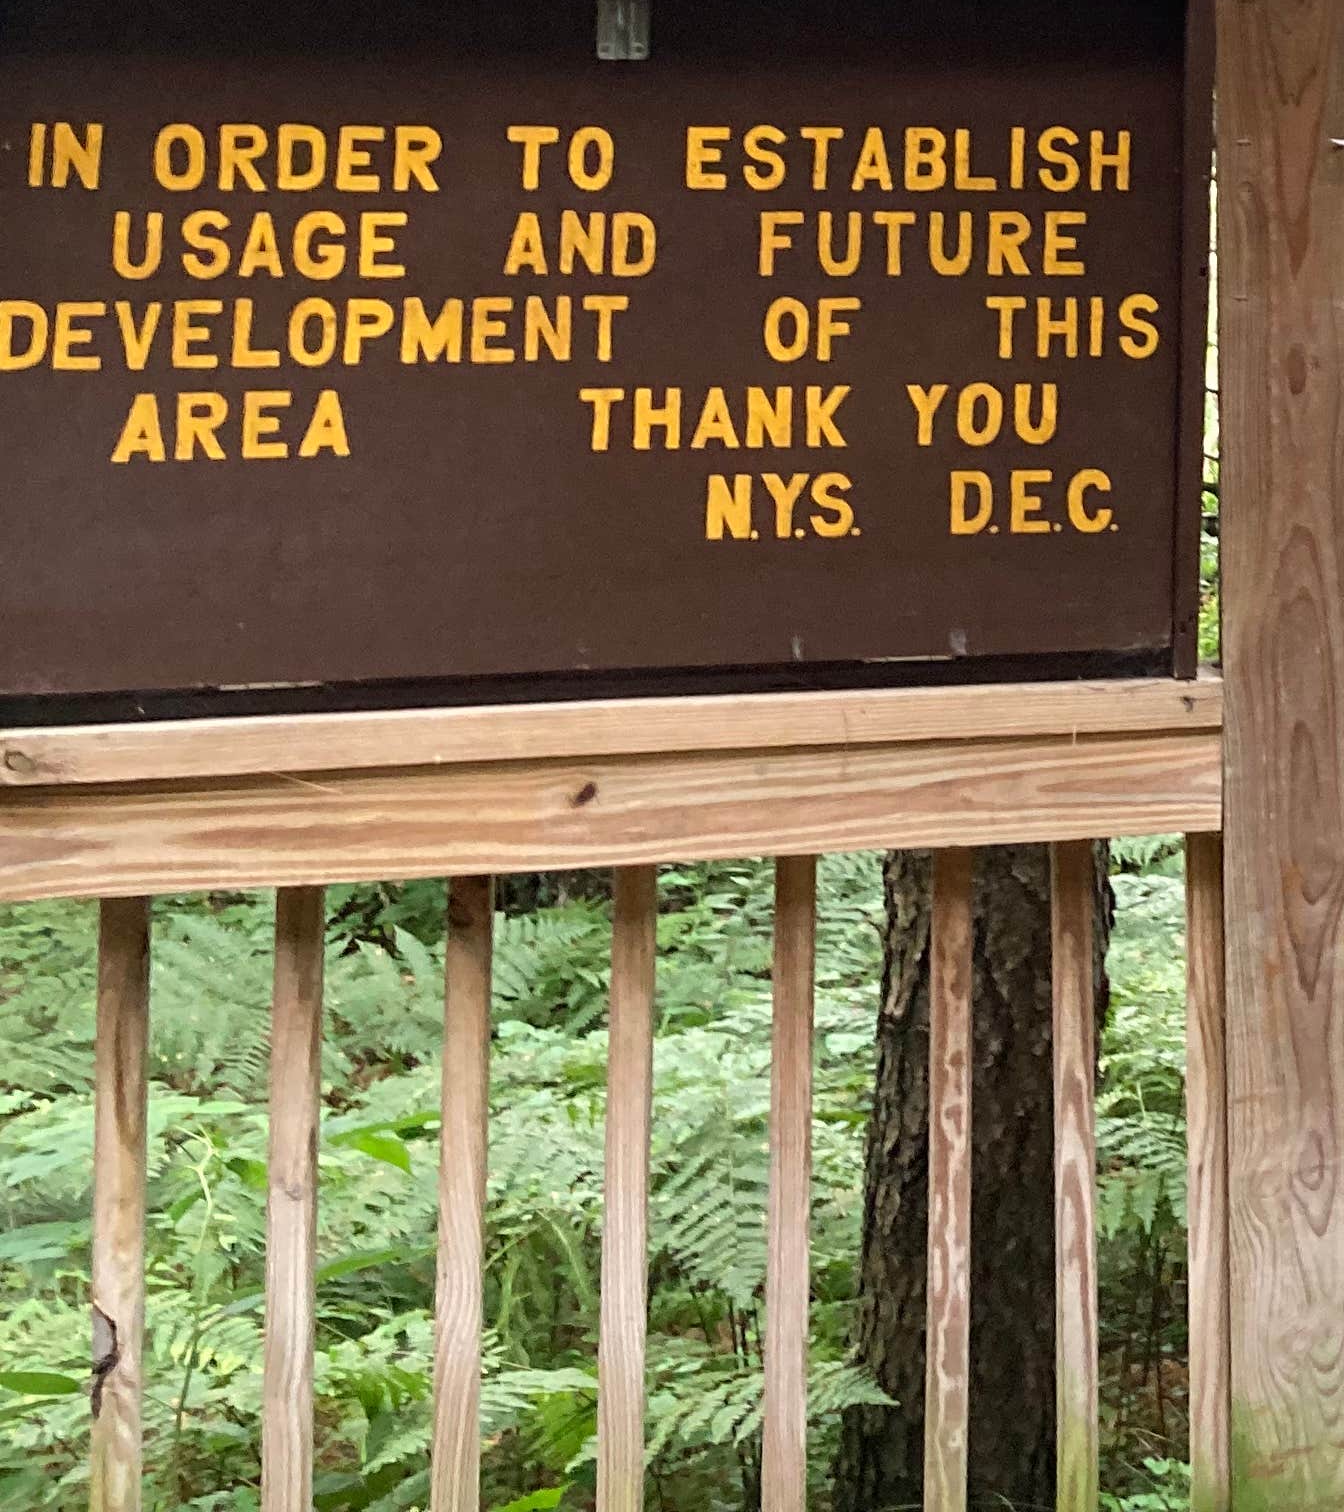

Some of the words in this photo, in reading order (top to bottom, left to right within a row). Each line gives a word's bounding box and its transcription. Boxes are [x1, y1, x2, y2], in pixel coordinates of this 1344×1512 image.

[28, 122, 104, 190] IN
[152, 123, 443, 193] ORDER
[506, 125, 615, 192] TO
[685, 124, 1131, 192] ESTABLISH
[112, 209, 409, 281] USAGE
[503, 209, 657, 278] AND
[759, 210, 1087, 277] FUTURE
[0, 294, 630, 372] DEVELOPMENT
[763, 296, 862, 363] OF
[985, 293, 1160, 360] THIS
[110, 388, 351, 465] AREA
[578, 384, 852, 452] THANK
[906, 382, 1058, 447] YOU
[704, 471, 861, 541] N.Y.S.
[950, 468, 1117, 535] D.E.C.
